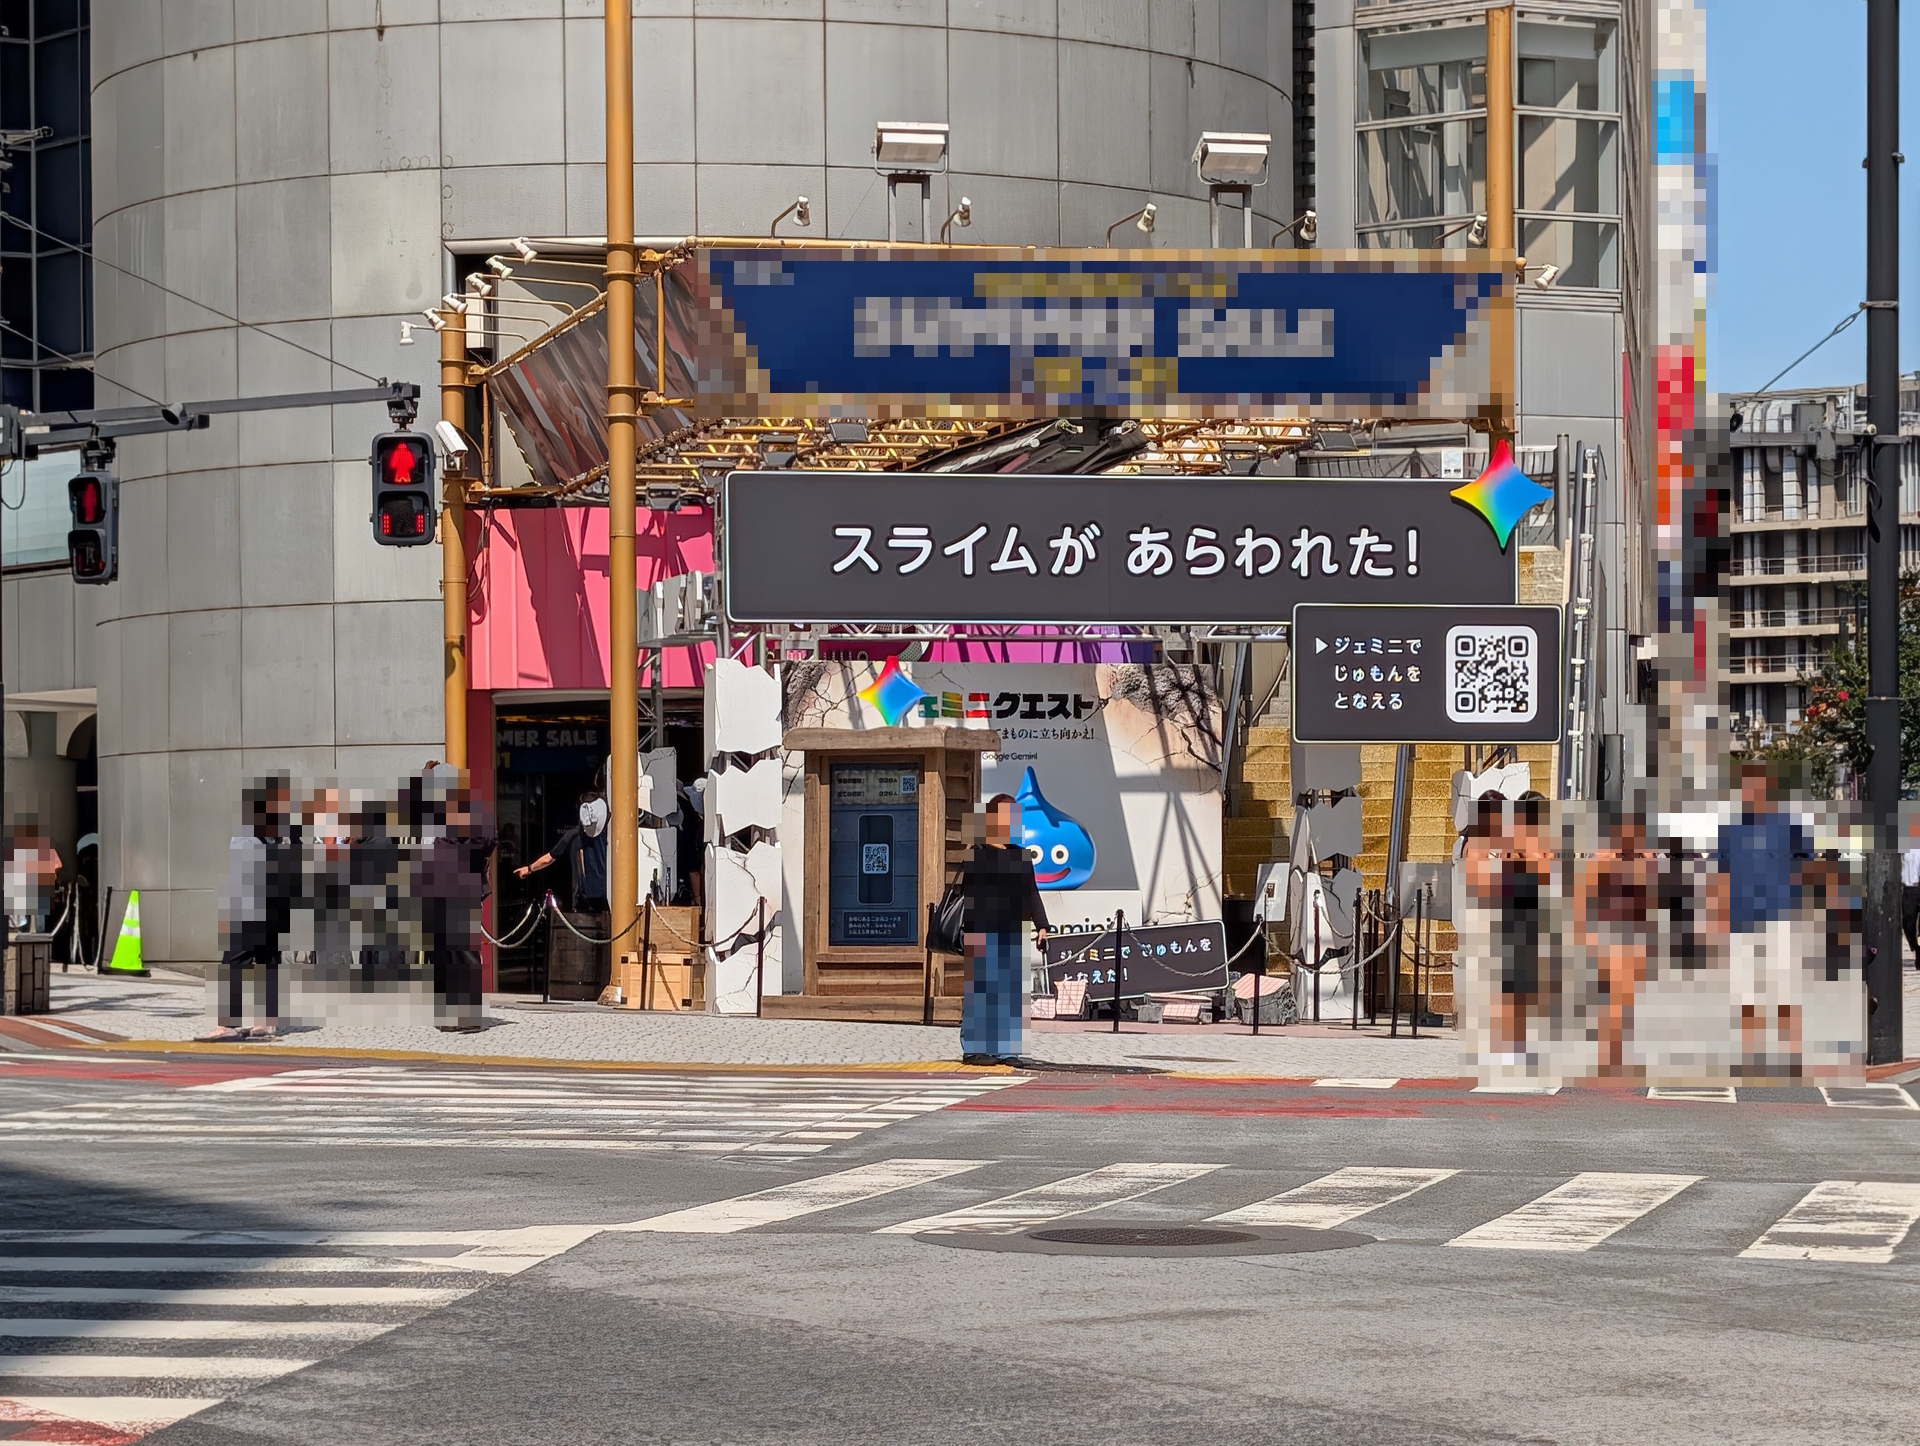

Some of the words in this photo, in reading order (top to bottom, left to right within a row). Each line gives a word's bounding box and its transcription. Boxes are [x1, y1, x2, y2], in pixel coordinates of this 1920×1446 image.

[832, 522, 1101, 577] スライムが
[1126, 524, 1419, 577] あらわれた!
[1335, 637, 1422, 654] ジェミニで
[1335, 664, 1421, 682] じゅもんを
[918, 691, 1094, 720] ェミニクエスト
[1335, 692, 1403, 710] となえる
[546, 730, 597, 748] SALE
[996, 727, 1094, 740] まものに立ち向かえ!
[982, 752, 1009, 762] Google
[1011, 752, 1038, 761] Gemini
